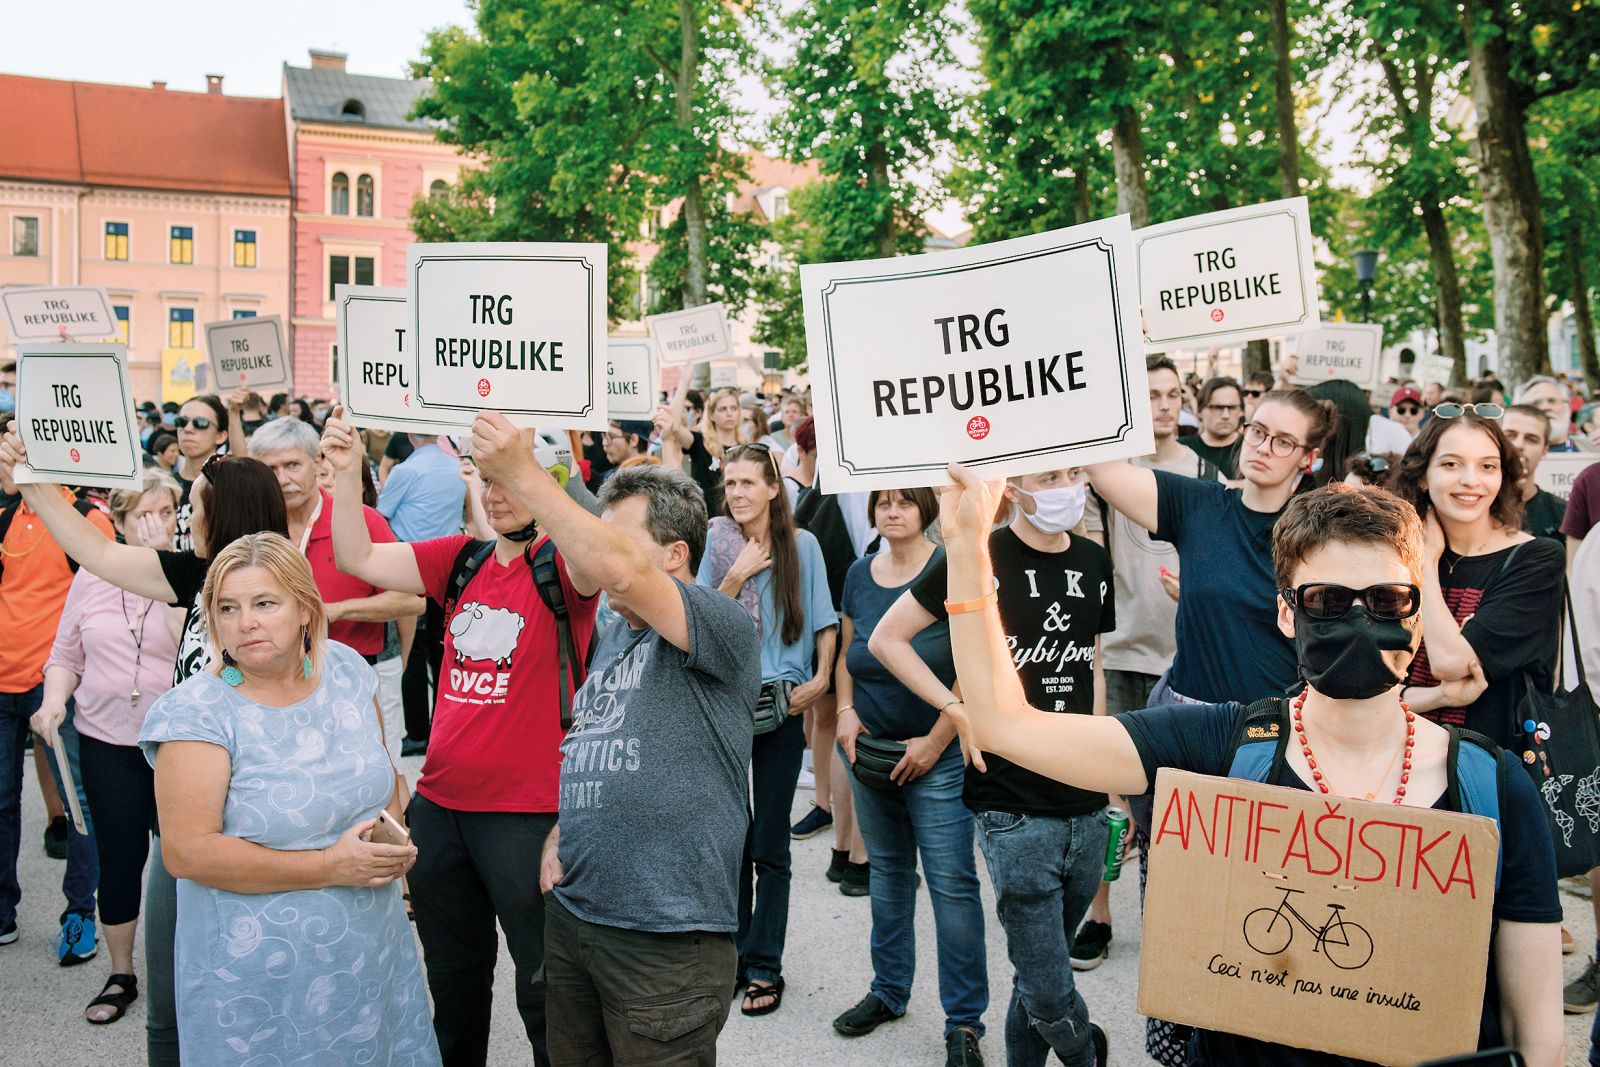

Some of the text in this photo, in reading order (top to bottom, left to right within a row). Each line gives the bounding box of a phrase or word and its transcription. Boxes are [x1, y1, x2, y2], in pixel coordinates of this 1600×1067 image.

[1194, 248, 1236, 273] TRG
[43, 299, 70, 310] TRG
[1160, 273, 1281, 311] REPUBLIKE
[24, 312, 98, 325] REPUBLIKE
[469, 294, 513, 325] TRG
[395, 329, 408, 352] T
[667, 333, 717, 351] REPUBLIKE
[680, 324, 697, 336] TRG
[933, 308, 1010, 355] TRG
[231, 339, 249, 353] TRG
[435, 337, 564, 372] REPUBLIKE
[1327, 340, 1345, 352] TRG
[220, 355, 272, 372] REPUBLIKE
[1306, 355, 1362, 368] REPUBLIKE
[362, 361, 409, 388] REPU
[873, 350, 1087, 417] REPUBLIKE
[51, 384, 82, 408] TRG
[607, 381, 639, 395] BLIKE
[31, 418, 117, 444] REPUBLIKE
[1043, 601, 1071, 631] &
[559, 781, 603, 809] STATE
[1156, 787, 1476, 899] ANTIFAŠISTKA
[1207, 954, 1420, 1011] Ceci n'est pas une insulte
